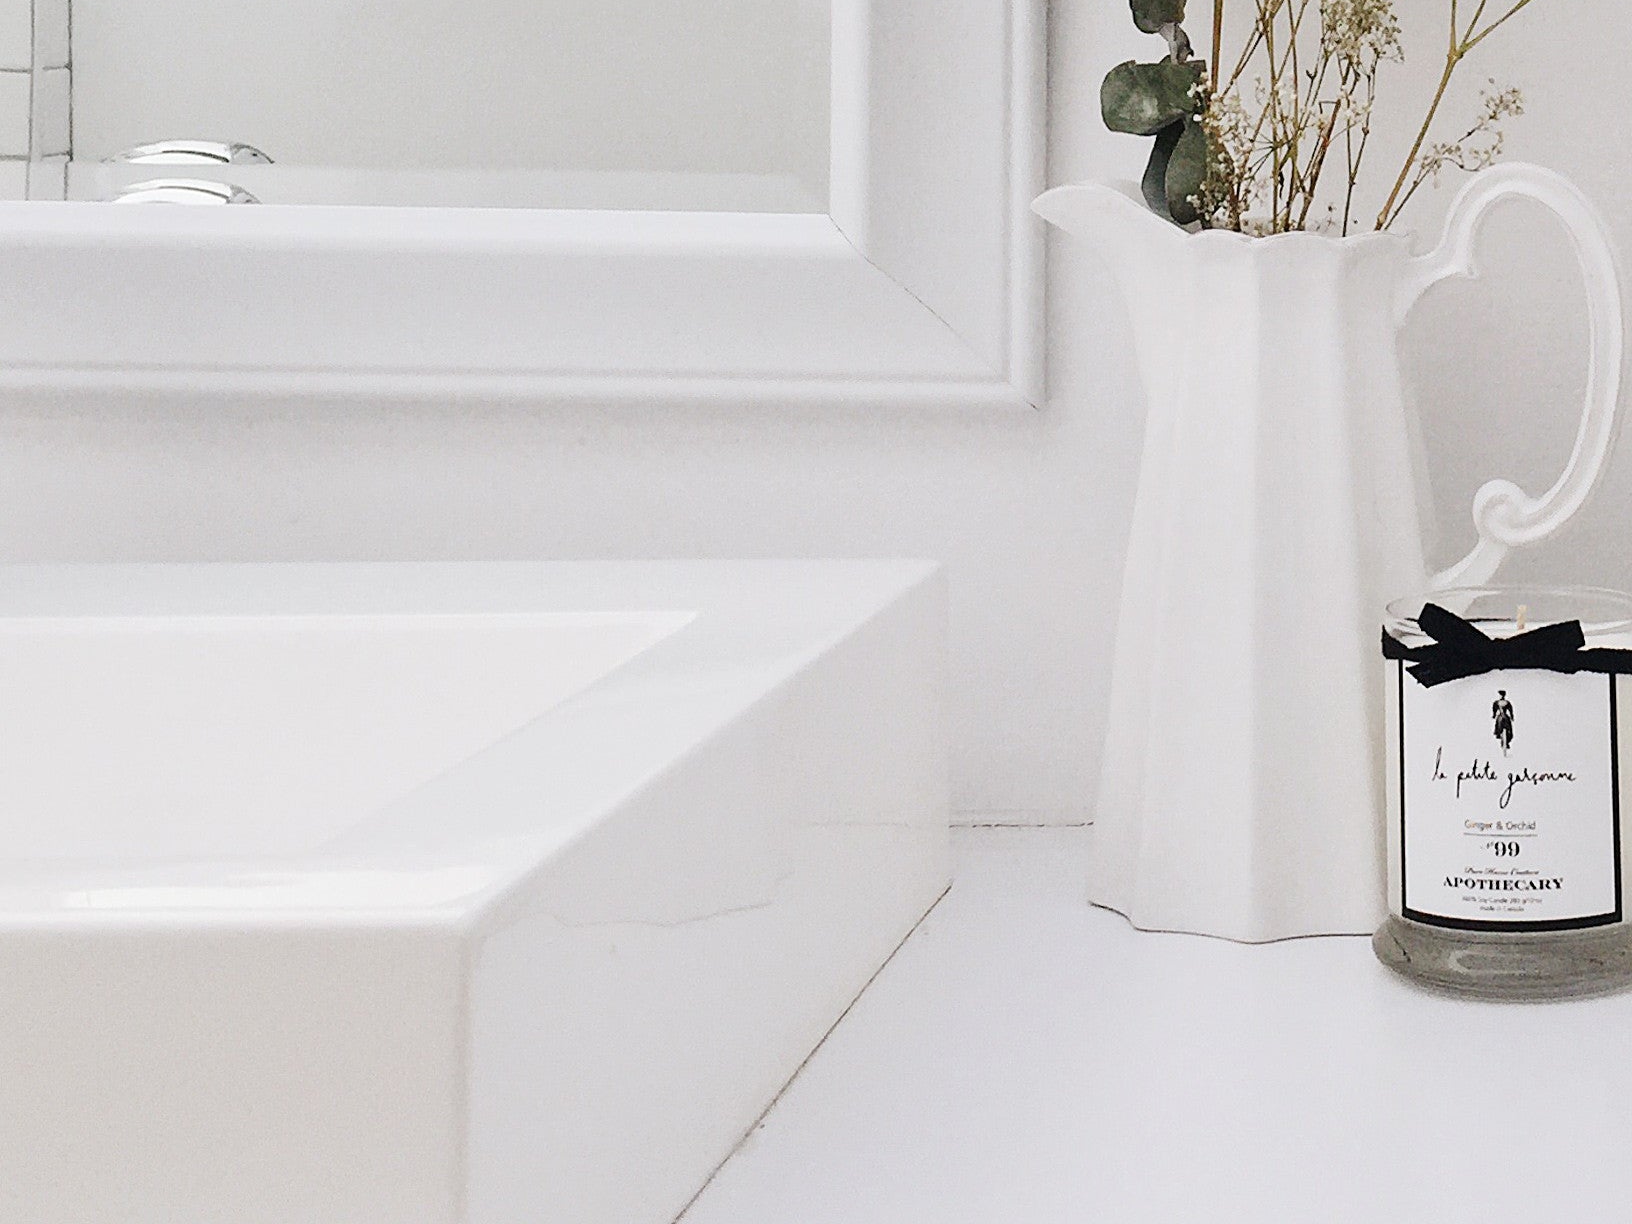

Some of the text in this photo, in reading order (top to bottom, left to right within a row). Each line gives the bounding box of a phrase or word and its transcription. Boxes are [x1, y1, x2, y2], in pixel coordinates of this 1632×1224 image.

[1456, 758, 1498, 799] petite
[1464, 819, 1537, 832] Ginger & Orchid
[1494, 841, 1521, 858] 99
[1443, 875, 1564, 892] APOTHECARY
